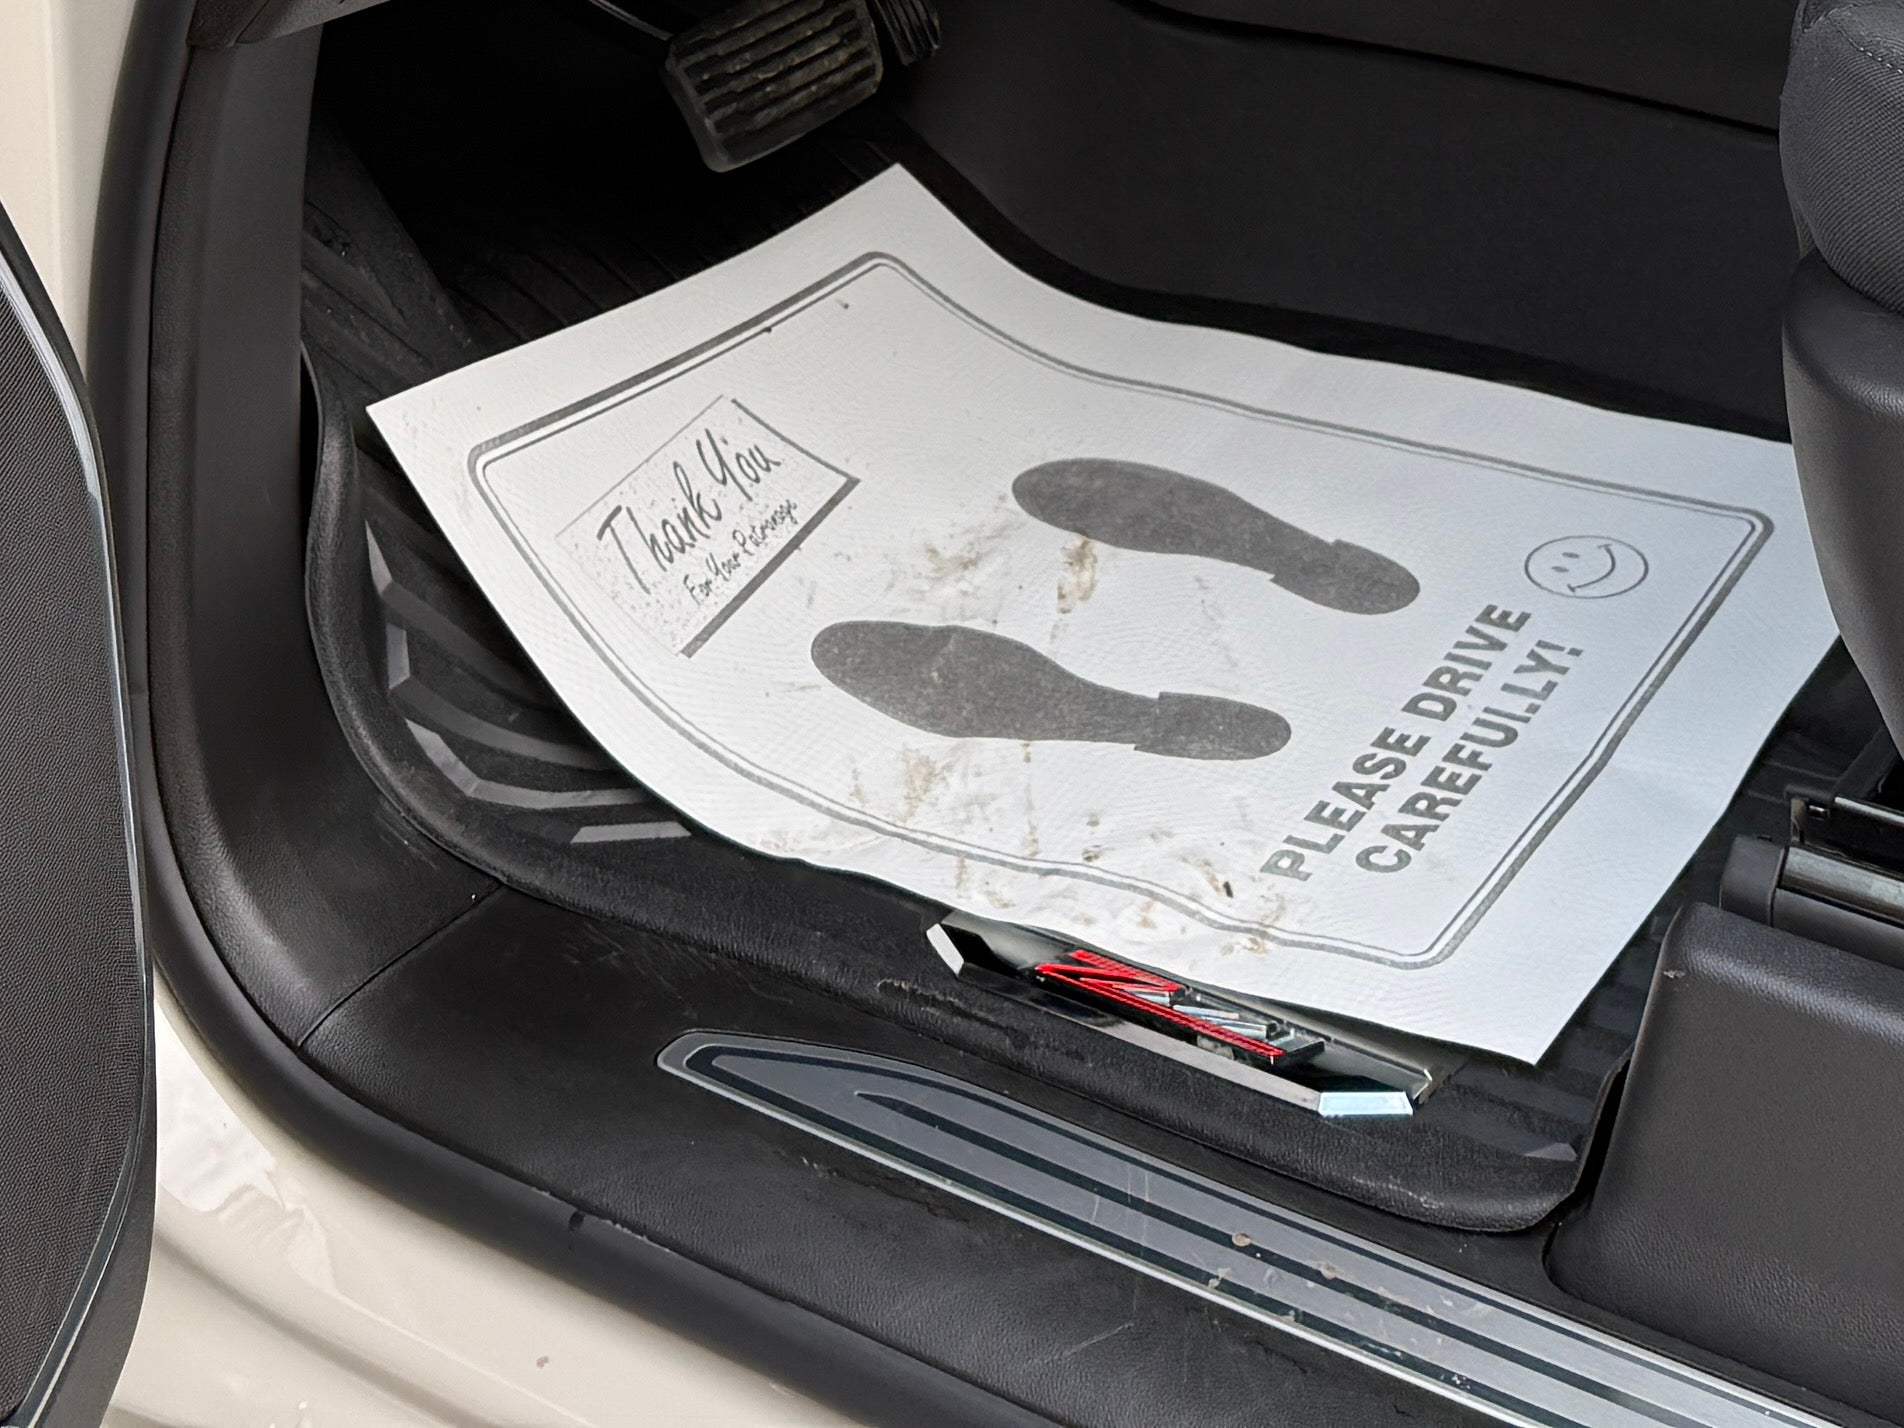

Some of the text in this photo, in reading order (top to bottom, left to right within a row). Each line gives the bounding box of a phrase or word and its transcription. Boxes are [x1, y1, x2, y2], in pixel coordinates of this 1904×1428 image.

[596, 428, 782, 596] Thank You
[682, 573, 713, 606] For
[705, 552, 741, 582] Your
[1259, 602, 1532, 881] PLEASE DRIVE
[1354, 639, 1584, 874] CAREFULLY!
